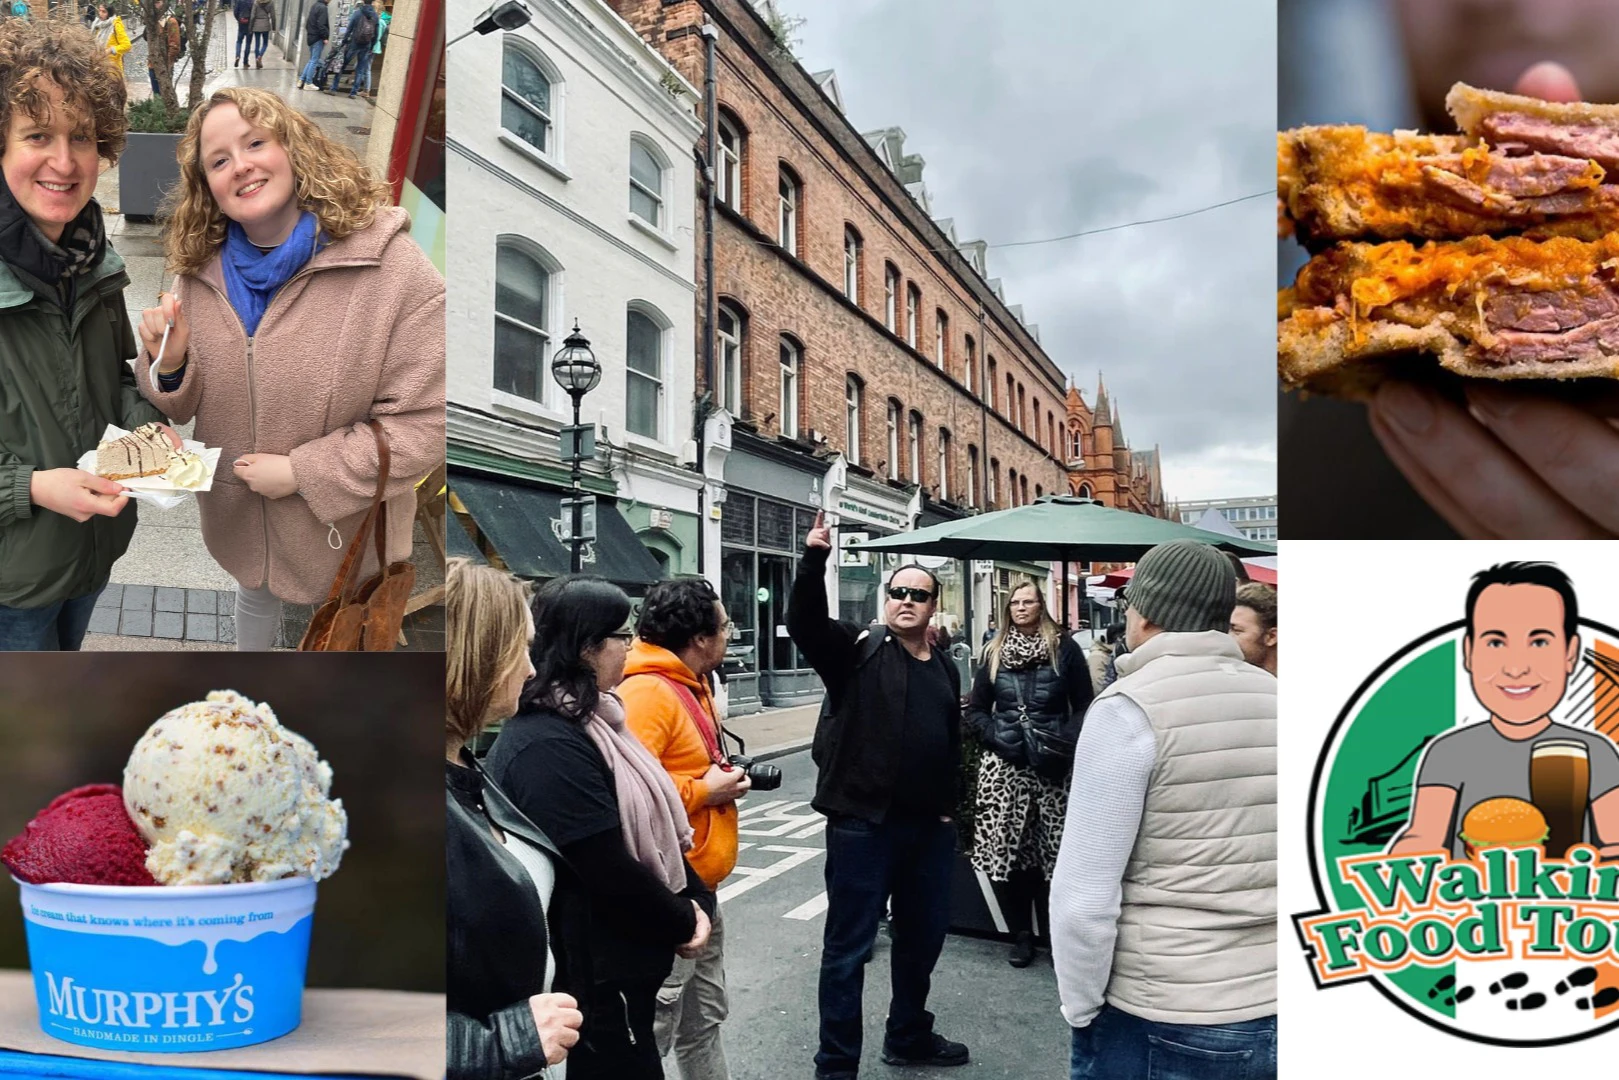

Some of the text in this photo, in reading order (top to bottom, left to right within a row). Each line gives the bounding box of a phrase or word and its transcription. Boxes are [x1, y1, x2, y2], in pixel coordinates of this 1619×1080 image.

[41, 909, 64, 921] cream
[66, 912, 88, 924] that
[89, 914, 129, 927] knows
[133, 916, 173, 928] where
[176, 916, 195, 928] it's
[198, 913, 245, 926] coming
[247, 911, 274, 923] from
[1314, 902, 1619, 970] Food To
[44, 971, 255, 1029] MURPHY'S
[73, 1026, 214, 1044] HANDMADE IN DINGLE
